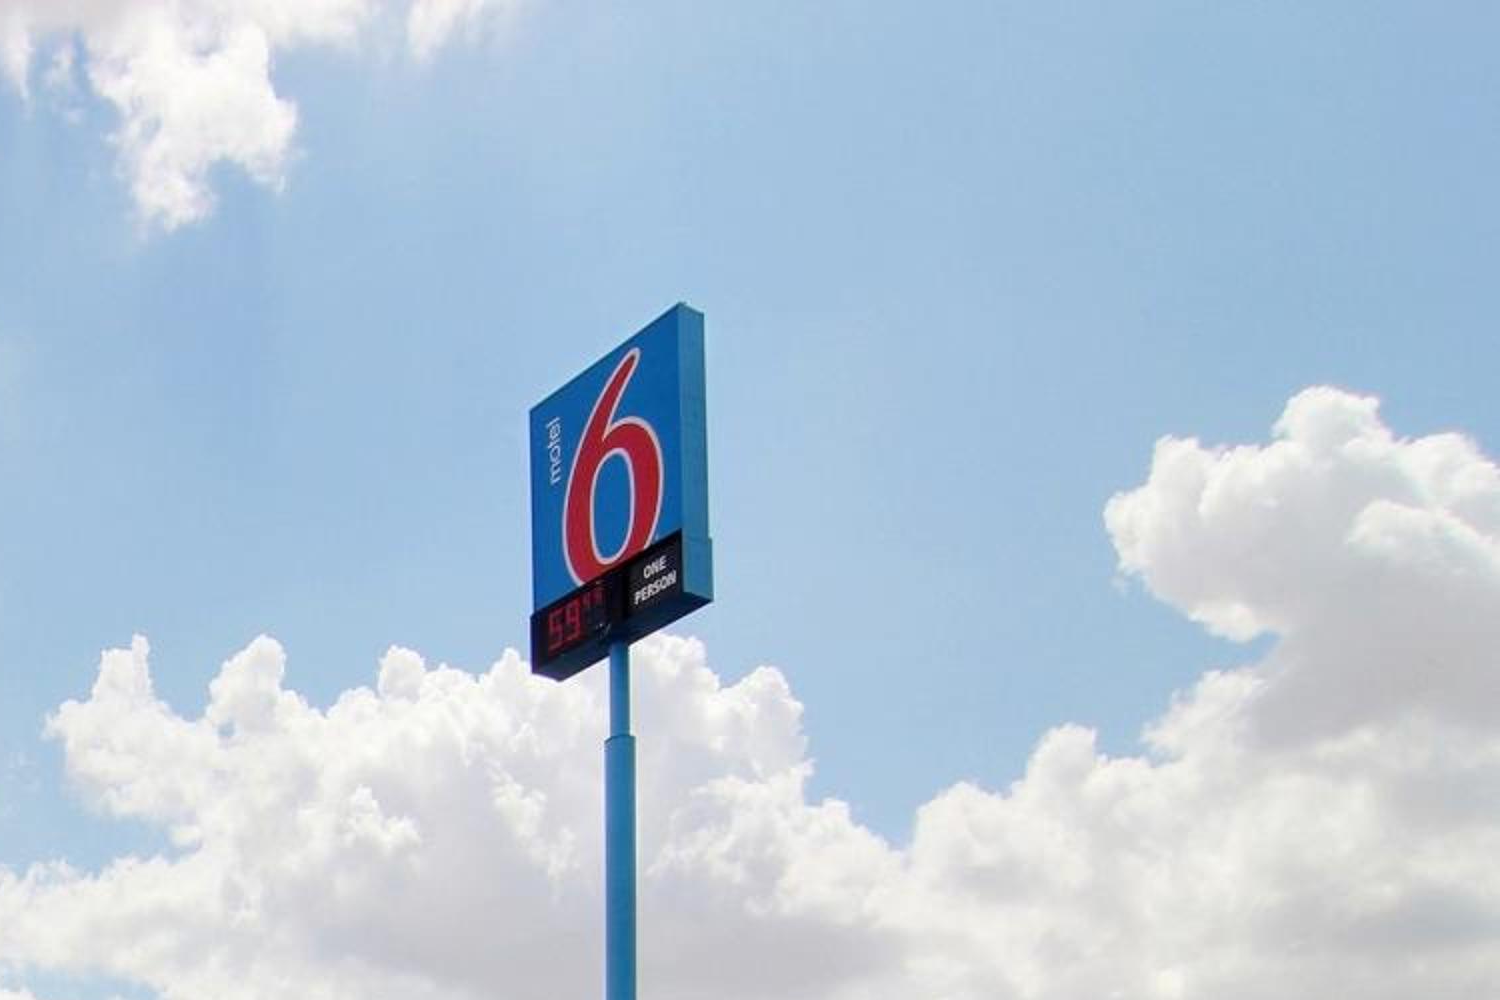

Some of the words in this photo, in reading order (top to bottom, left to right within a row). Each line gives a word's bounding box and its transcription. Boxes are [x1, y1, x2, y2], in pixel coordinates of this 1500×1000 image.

[545, 416, 561, 485] motel
[562, 347, 664, 588] 6
[633, 569, 677, 605] PERSON
[643, 555, 667, 579] ONE
